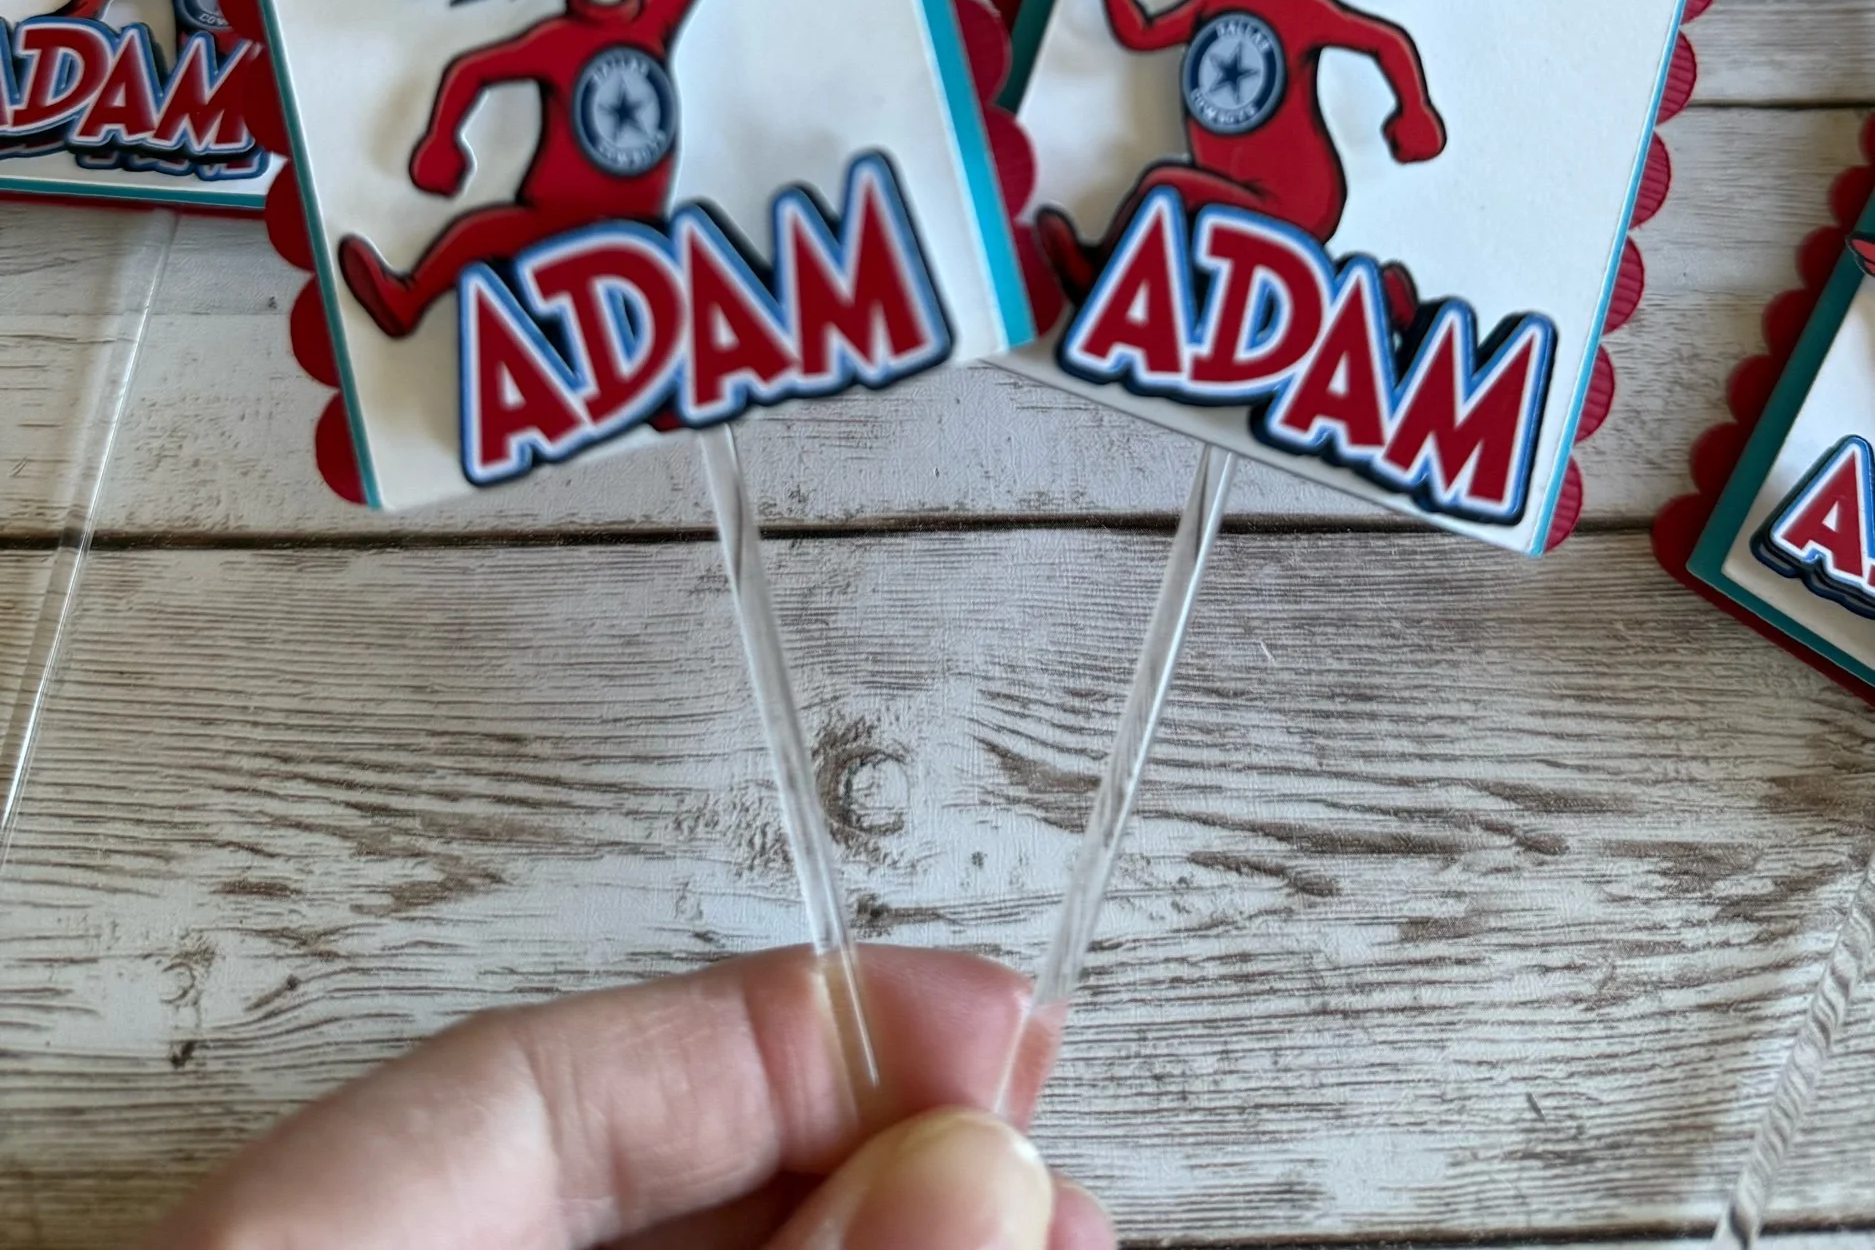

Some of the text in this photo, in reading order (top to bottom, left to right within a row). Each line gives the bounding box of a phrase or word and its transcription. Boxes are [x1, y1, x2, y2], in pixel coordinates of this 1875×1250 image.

[0, 19, 260, 155] DAM
[462, 156, 945, 478] ADAM
[1064, 190, 1553, 519] ADAM
